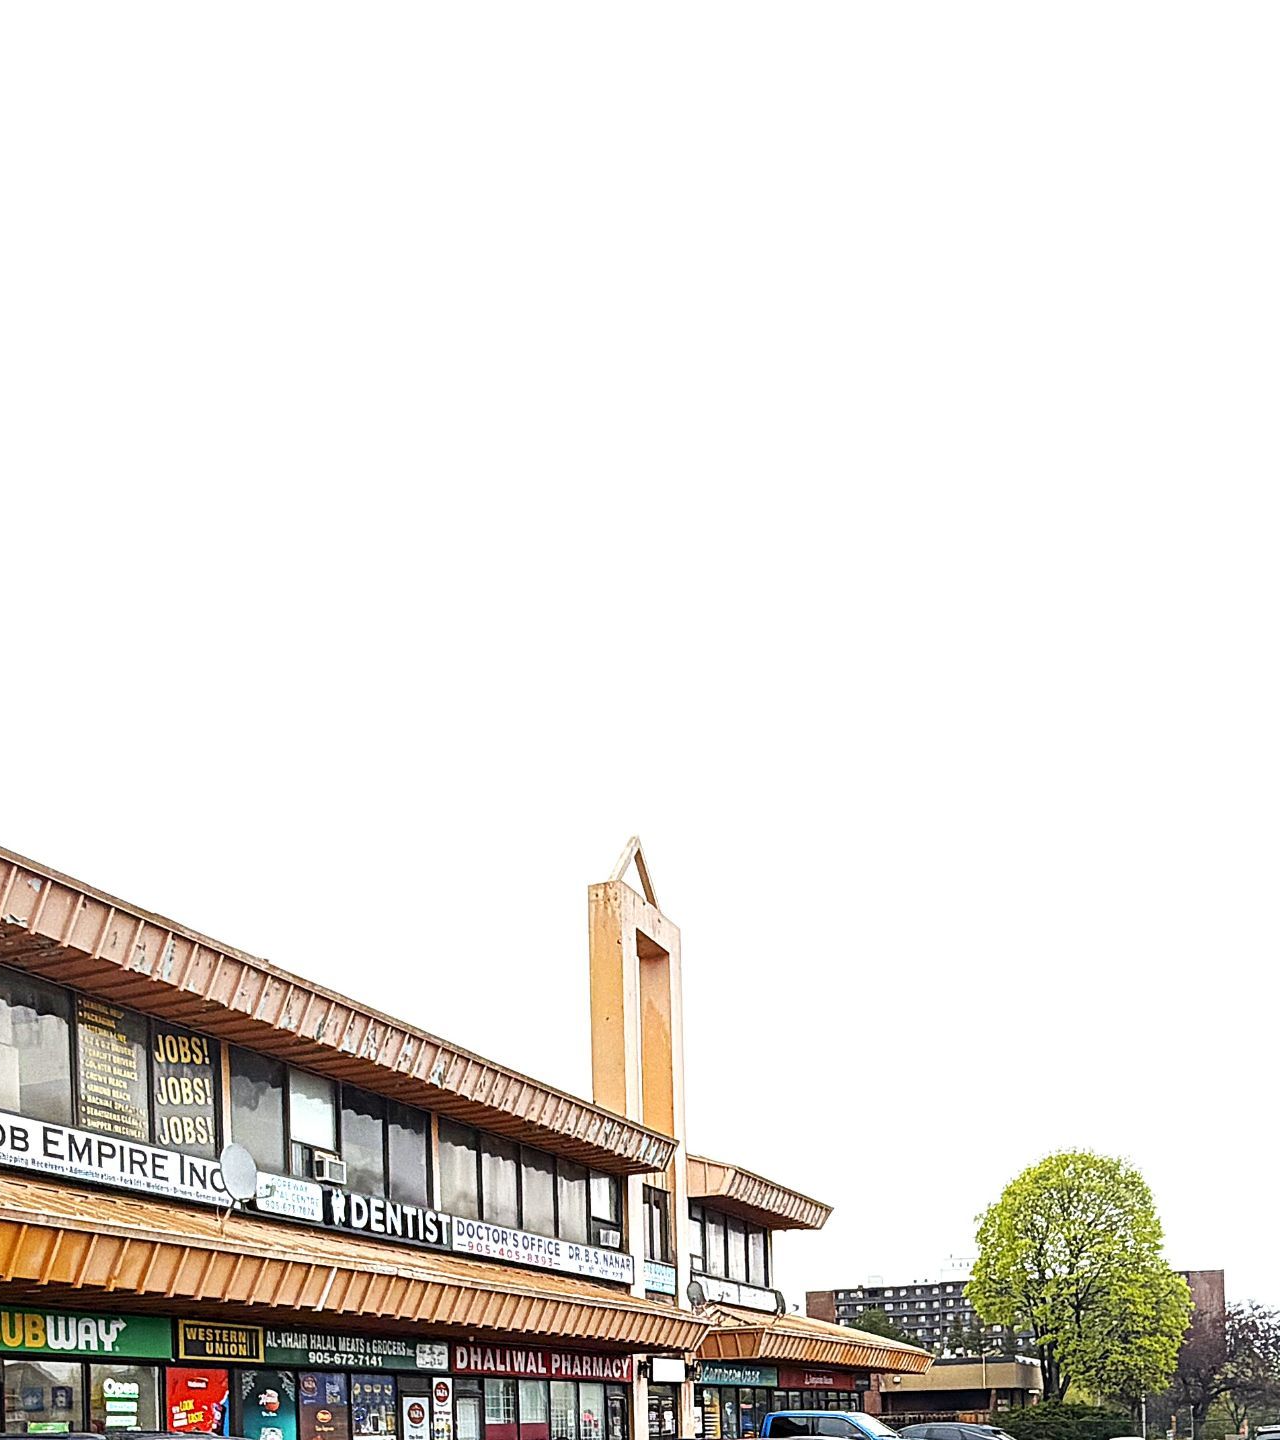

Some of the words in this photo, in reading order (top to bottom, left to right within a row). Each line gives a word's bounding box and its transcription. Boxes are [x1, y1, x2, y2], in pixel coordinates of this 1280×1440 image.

[155, 1034, 211, 1065] JOBS!
[157, 1077, 213, 1106] JOBS!
[160, 1116, 215, 1145] JOBS!
[42, 1127, 169, 1182] EMPIRE
[351, 1193, 450, 1244] DENTIST
[457, 1220, 519, 1249] DOCTOR'S
[522, 1235, 561, 1257] OFFICE
[568, 1245, 583, 1261] DR.
[185, 1327, 247, 1343] WESTERN
[205, 1341, 247, 1356] UNION
[266, 1331, 308, 1350] AL-KHAIR
[310, 1334, 337, 1352] HALAL
[339, 1337, 365, 1353] MEATS
[372, 1340, 406, 1356] GROCERS
[308, 1352, 383, 1367] 905-672-7141
[456, 1346, 547, 1374] DHALIWAL
[551, 1353, 631, 1380] PHARMACY
